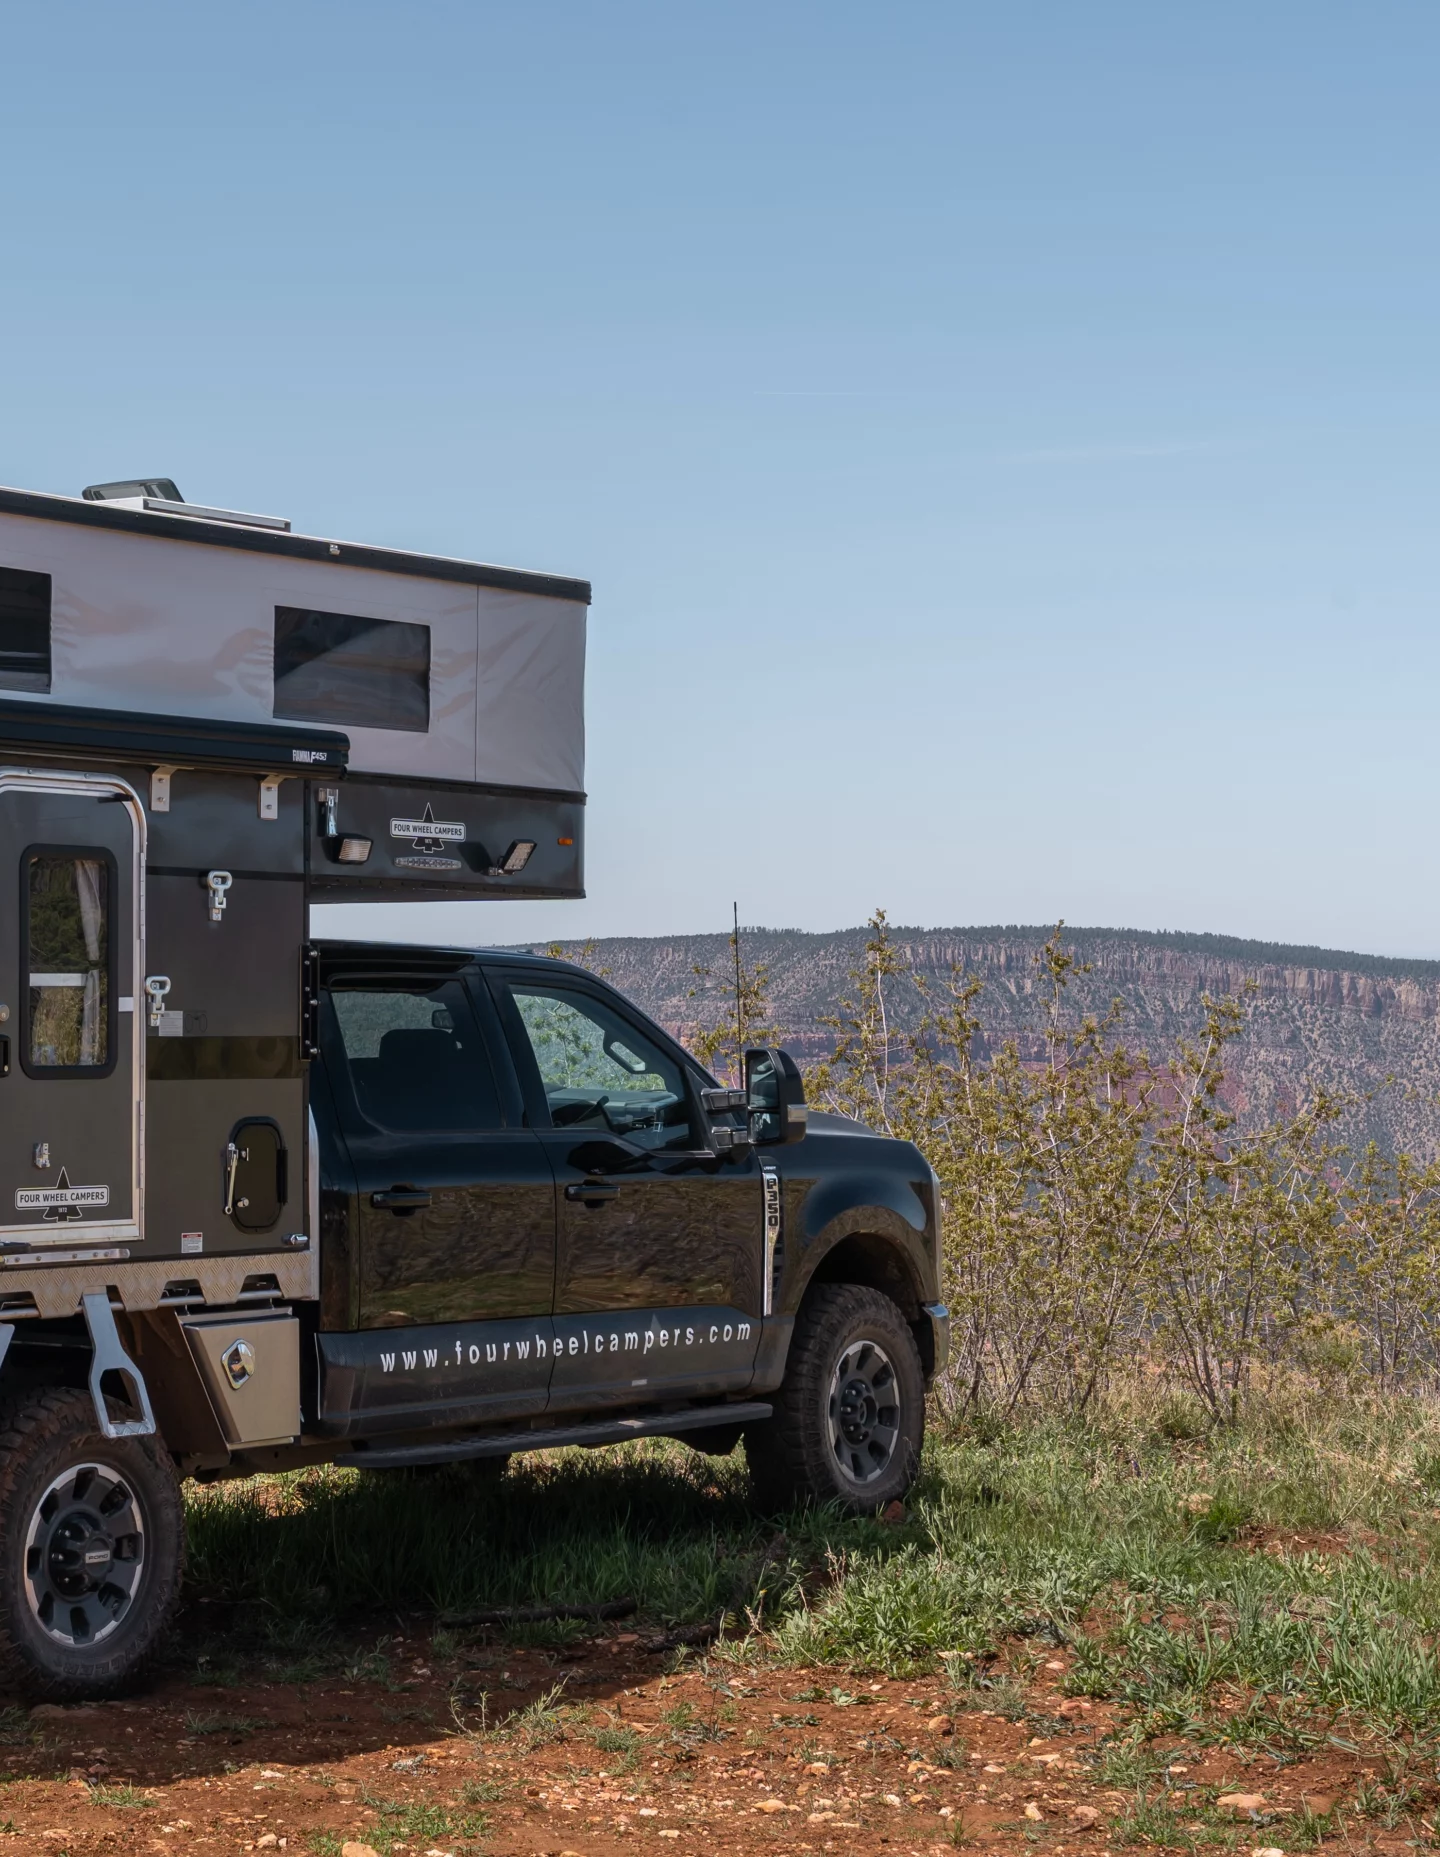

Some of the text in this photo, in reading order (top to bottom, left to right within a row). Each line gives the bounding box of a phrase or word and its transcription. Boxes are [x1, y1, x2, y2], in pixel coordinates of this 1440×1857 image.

[393, 823, 462, 837] FOUR WHEEL CAMPERS
[19, 1190, 105, 1203] FOUR WHEEL CAMPERS
[766, 1177, 779, 1227] F350
[380, 1321, 751, 1373] www.fourwheelcampers.com
